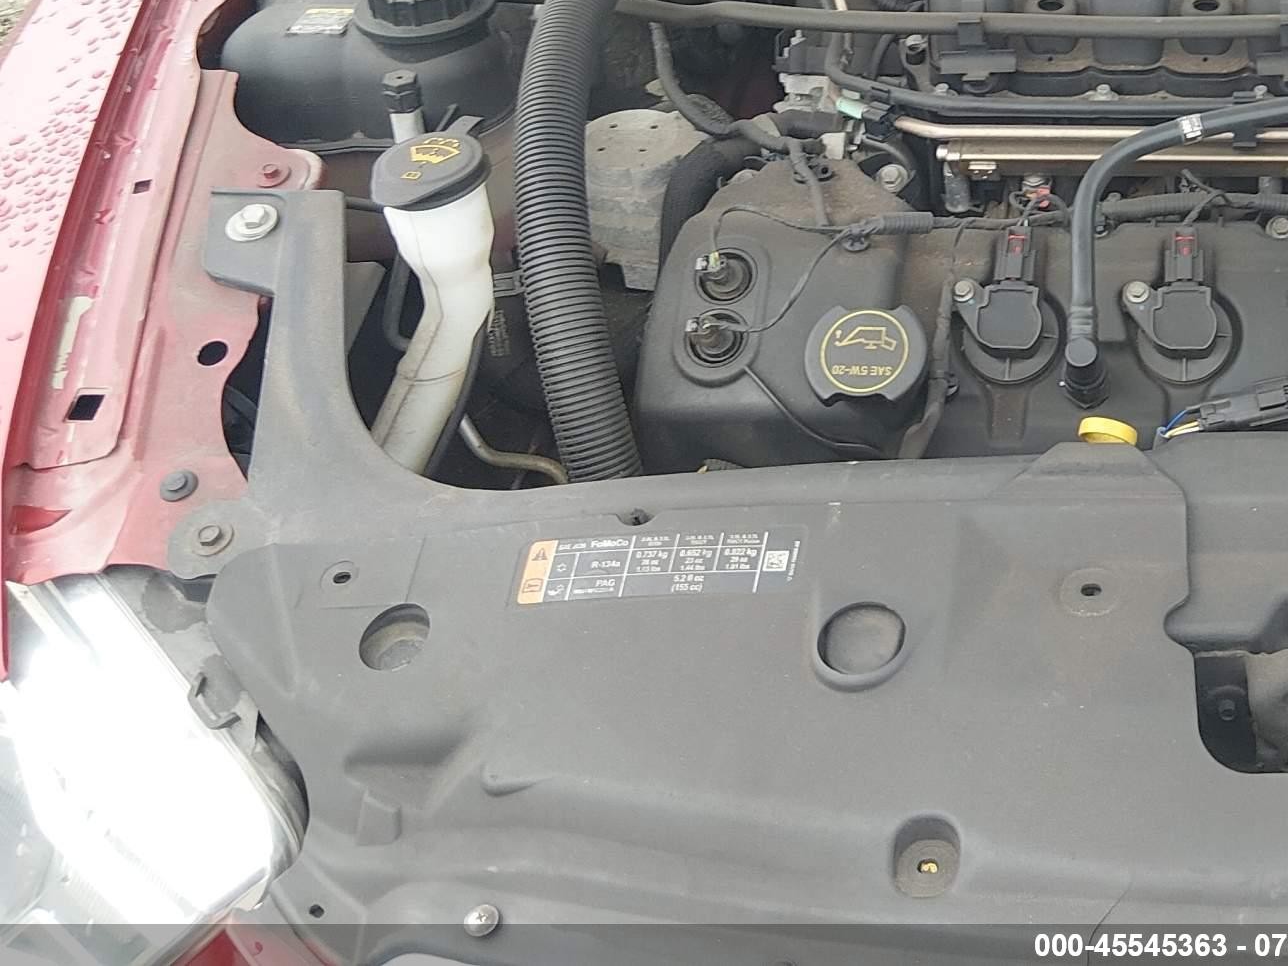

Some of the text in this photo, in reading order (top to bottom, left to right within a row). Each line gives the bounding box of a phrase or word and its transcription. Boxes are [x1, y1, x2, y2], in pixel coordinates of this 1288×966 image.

[831, 364, 892, 376] SAE 5W-20
[590, 538, 629, 548] FoMoCo
[658, 549, 669, 559] kg
[702, 548, 713, 558] kg
[746, 547, 758, 557] kg
[590, 560, 621, 569] R-134a
[595, 578, 616, 587] PAG
[673, 574, 687, 582] 5.2
[670, 583, 703, 593] (155 cc)
